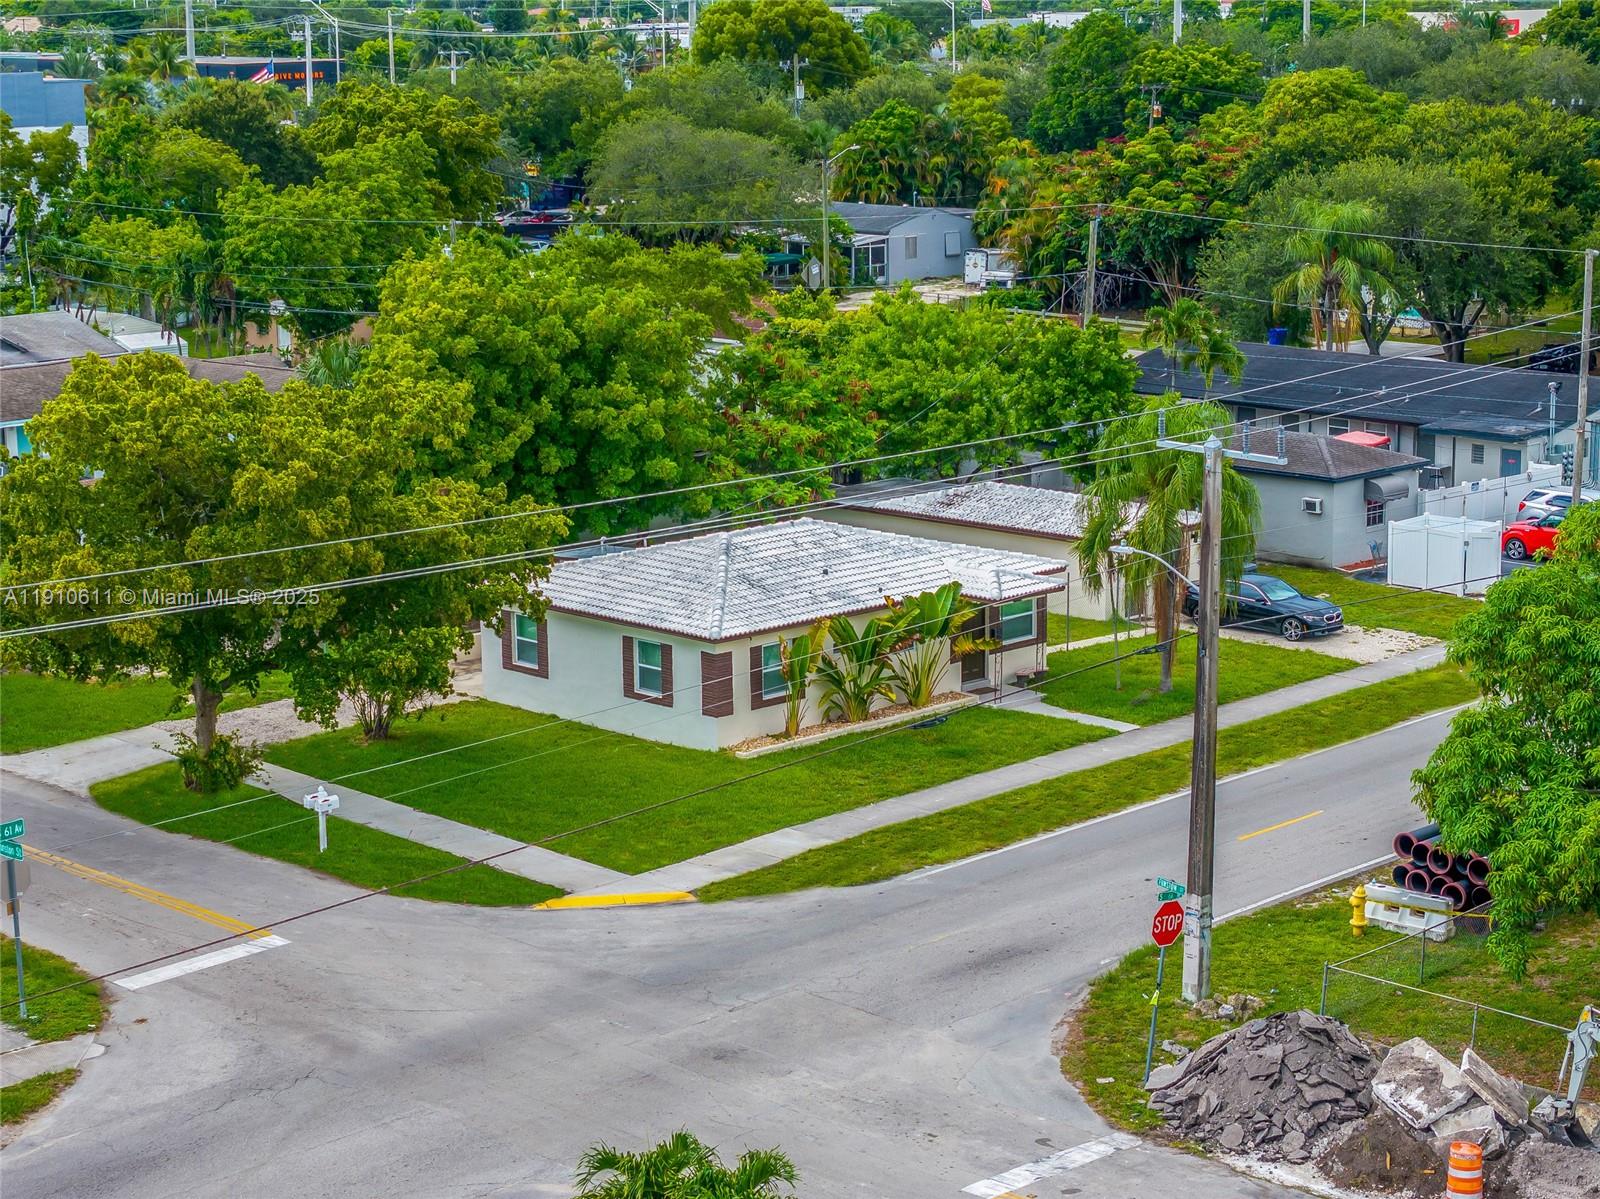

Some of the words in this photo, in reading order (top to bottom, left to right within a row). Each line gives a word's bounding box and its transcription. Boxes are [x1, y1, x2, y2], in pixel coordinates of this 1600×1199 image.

[294, 71, 324, 79] MORS
[4, 825, 13, 837] 61
[14, 824, 23, 834] Av
[1153, 913, 1183, 934] STOP
